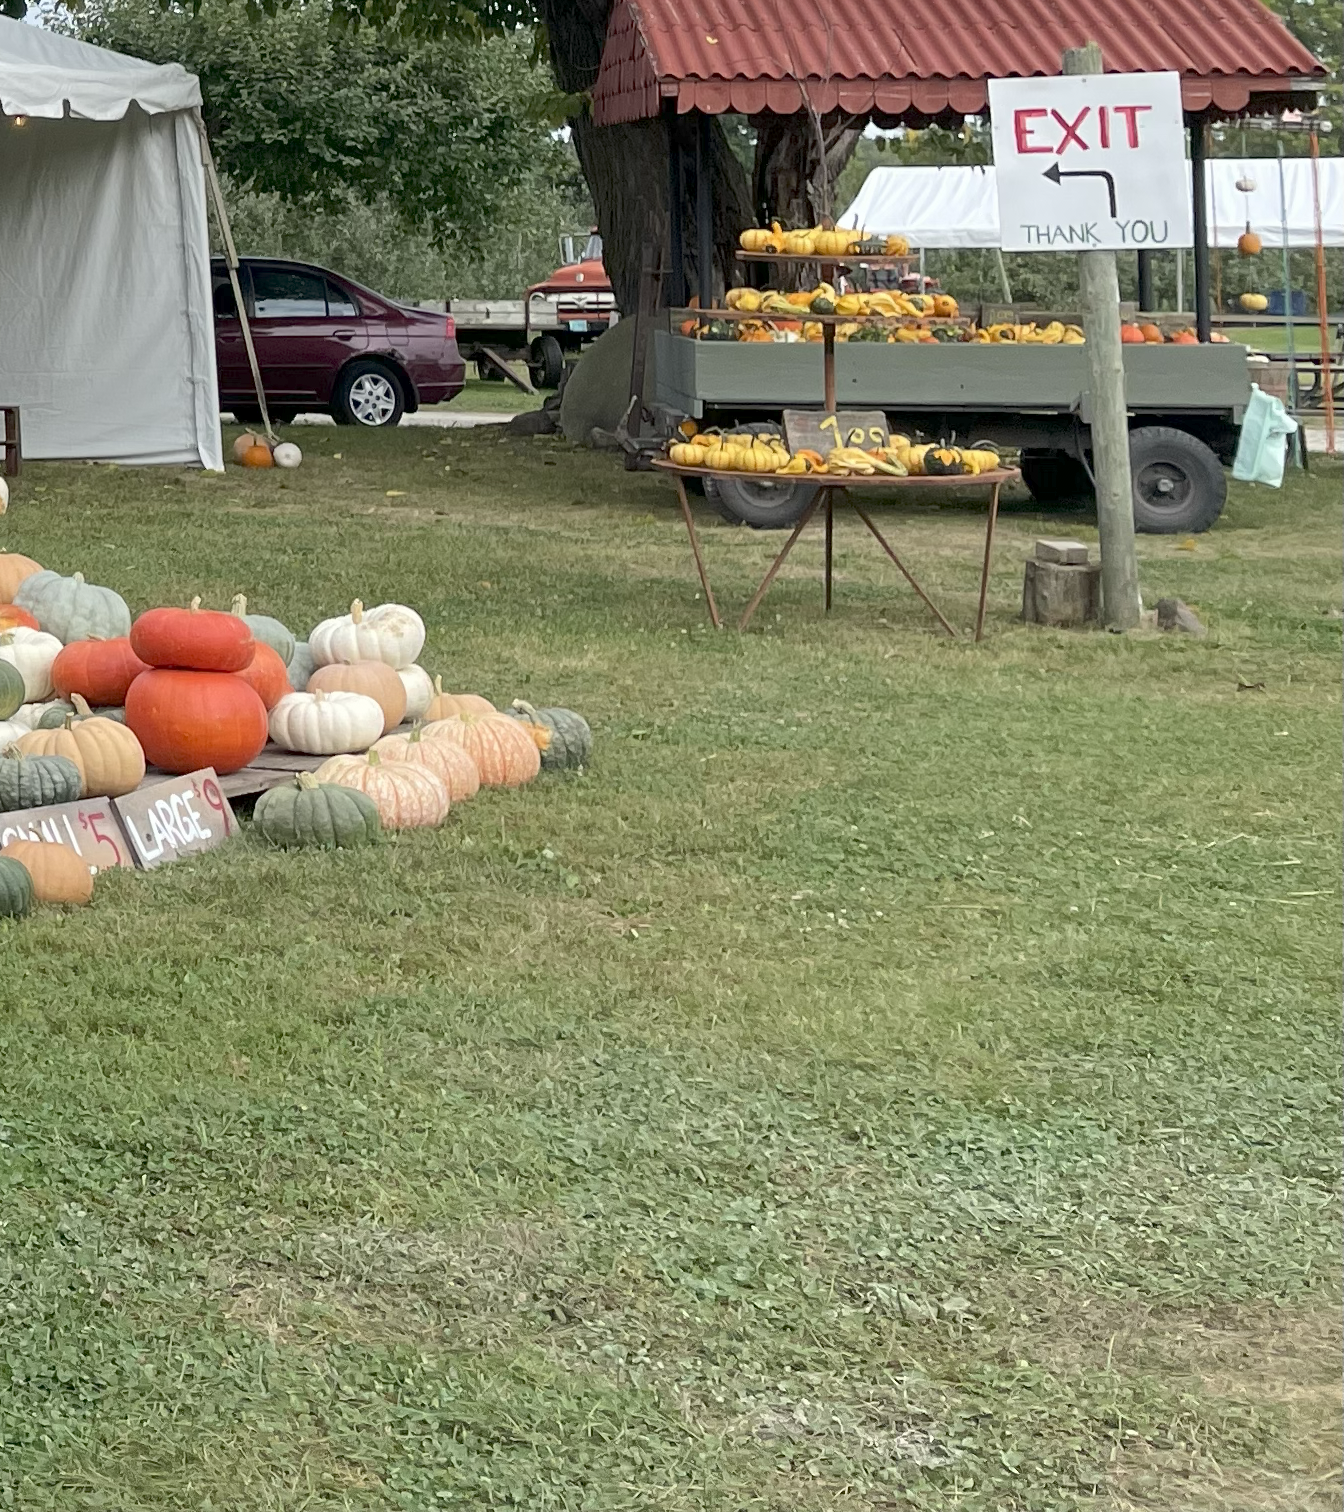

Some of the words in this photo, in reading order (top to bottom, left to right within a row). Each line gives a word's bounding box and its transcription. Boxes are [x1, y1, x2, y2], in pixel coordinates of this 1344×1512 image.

[1014, 105, 1152, 155] EXIT
[1020, 221, 1102, 245] THANK
[1115, 219, 1169, 244] YOU
[125, 790, 211, 861] LARGE
